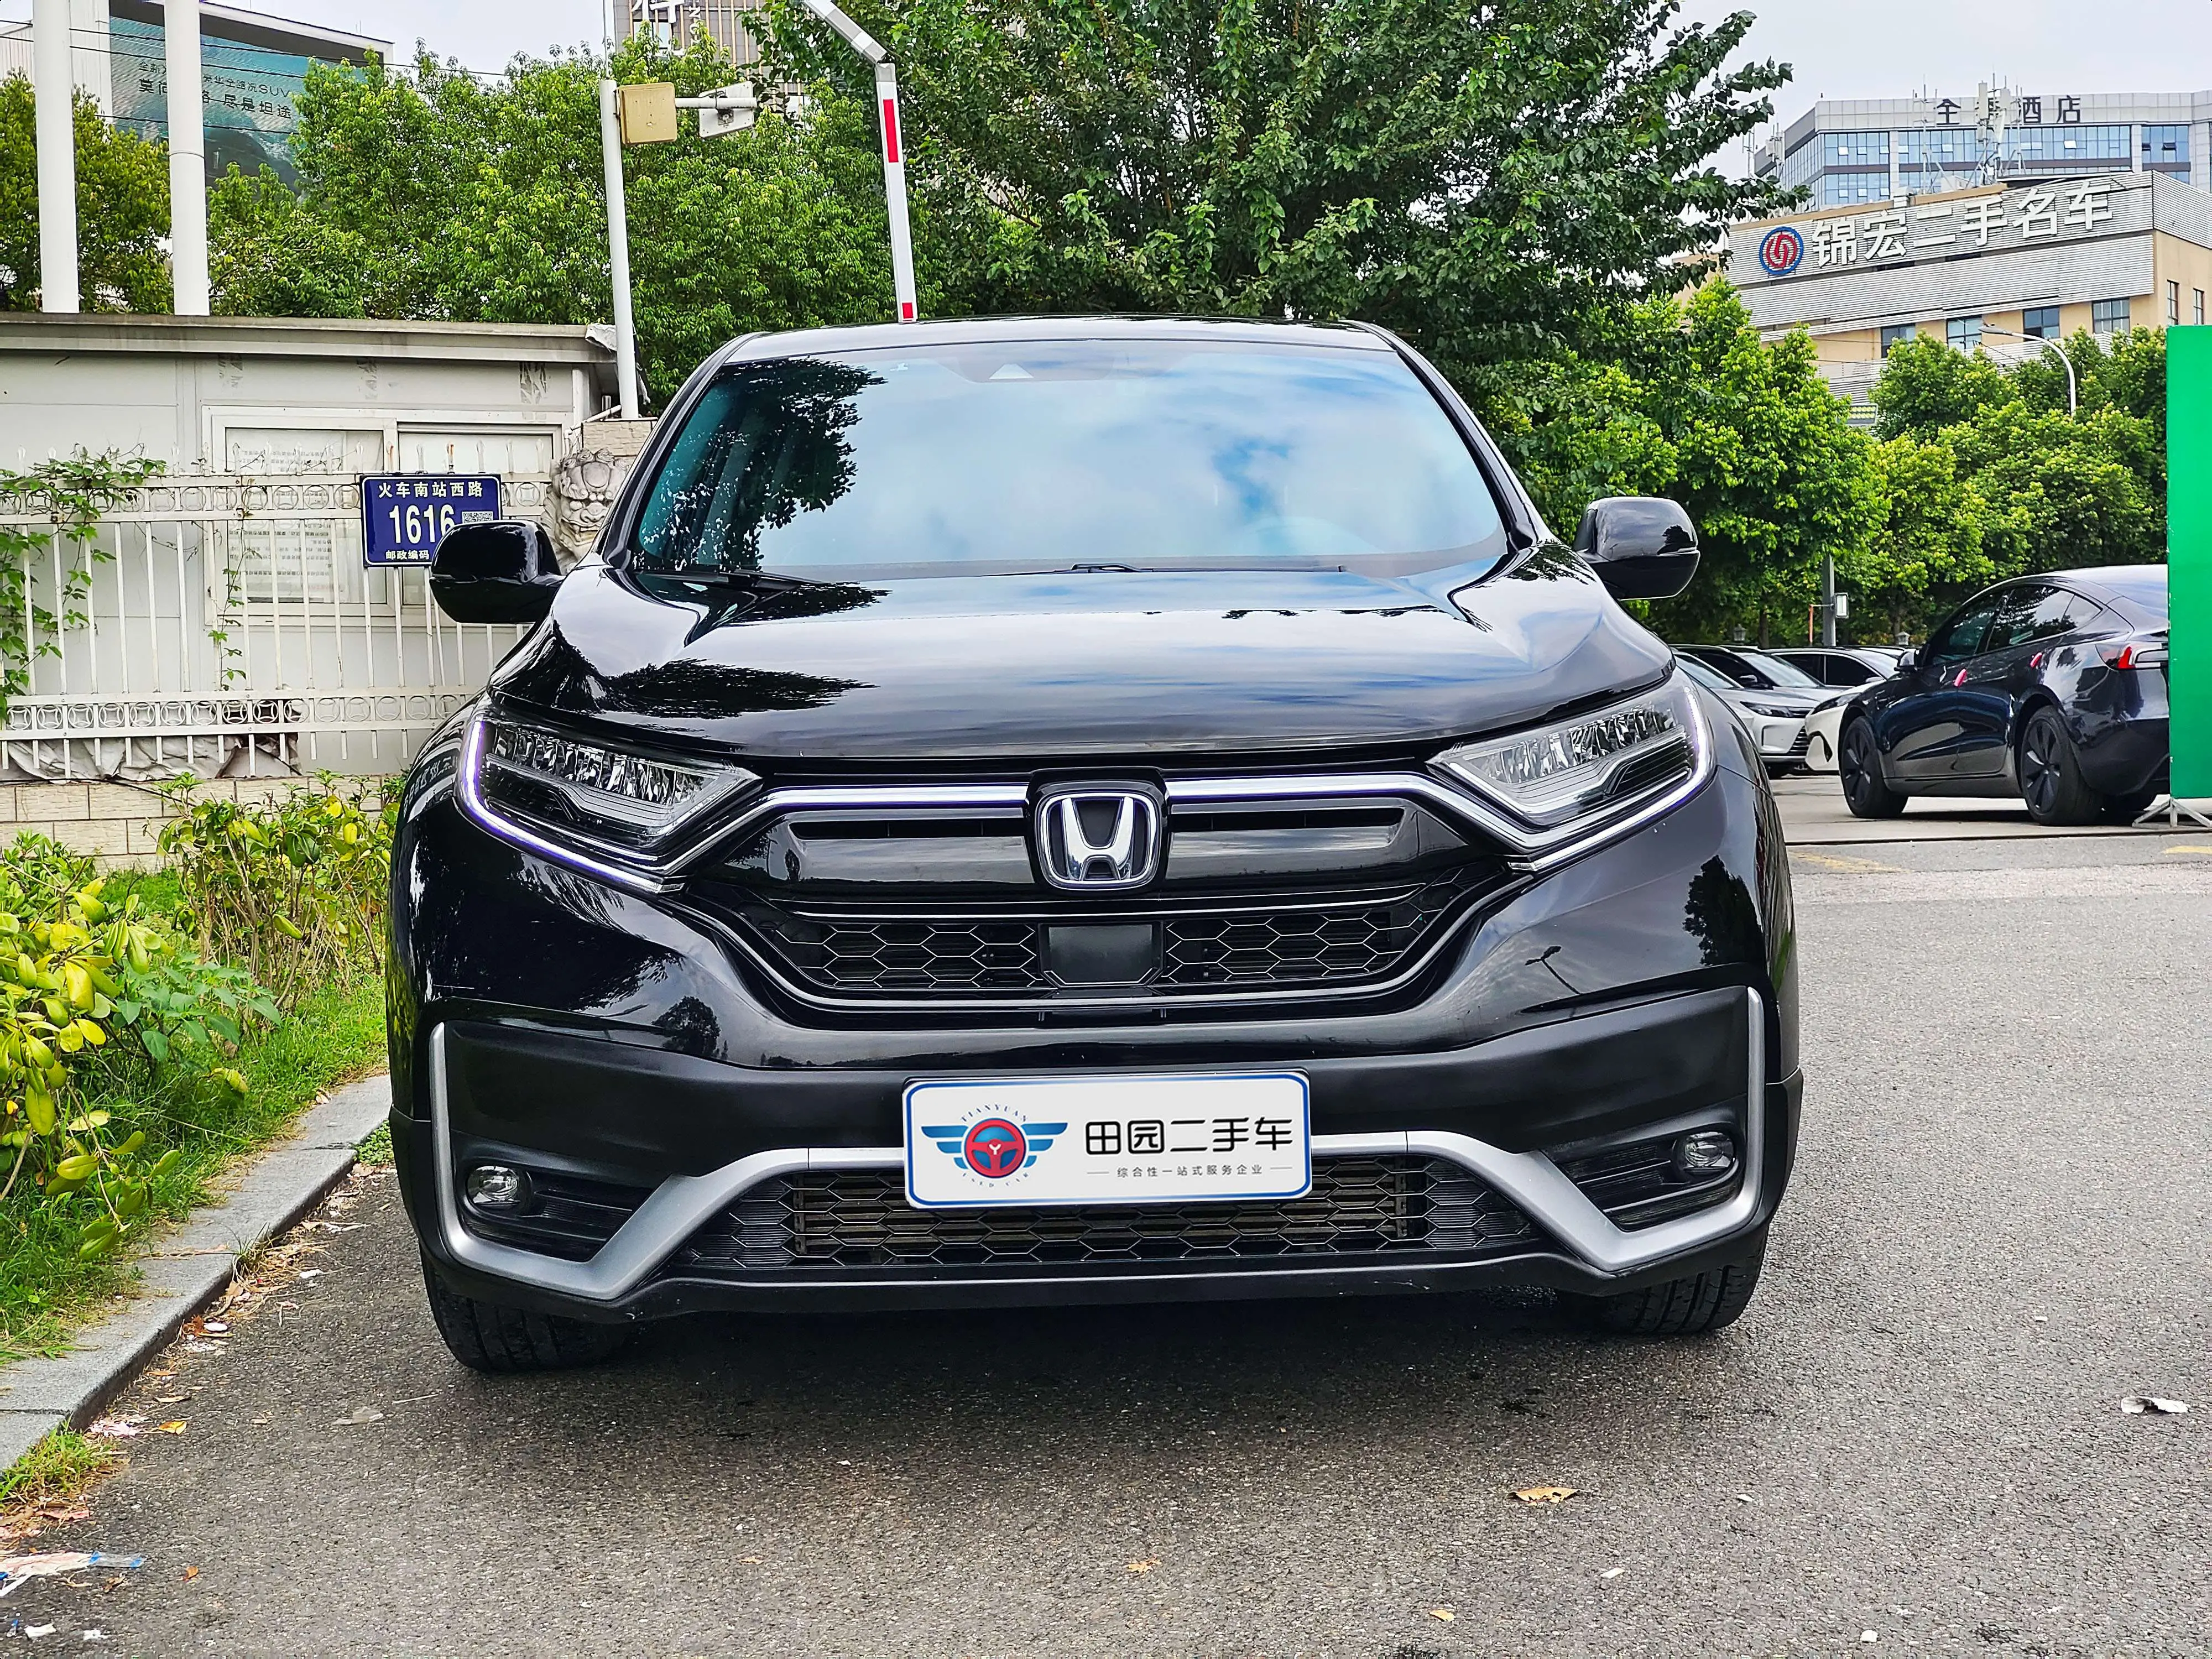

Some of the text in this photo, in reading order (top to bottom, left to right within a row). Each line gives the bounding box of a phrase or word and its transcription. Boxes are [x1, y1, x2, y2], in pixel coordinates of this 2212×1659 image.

[1812, 181, 2112, 267] 锦宏二手名车
[378, 481, 483, 498] 火车南站西路
[385, 550, 429, 560] 邮政编码
[1086, 1117, 1293, 1155] 田园二手车
[1117, 1164, 1262, 1178] 综合性一站式服务企业
